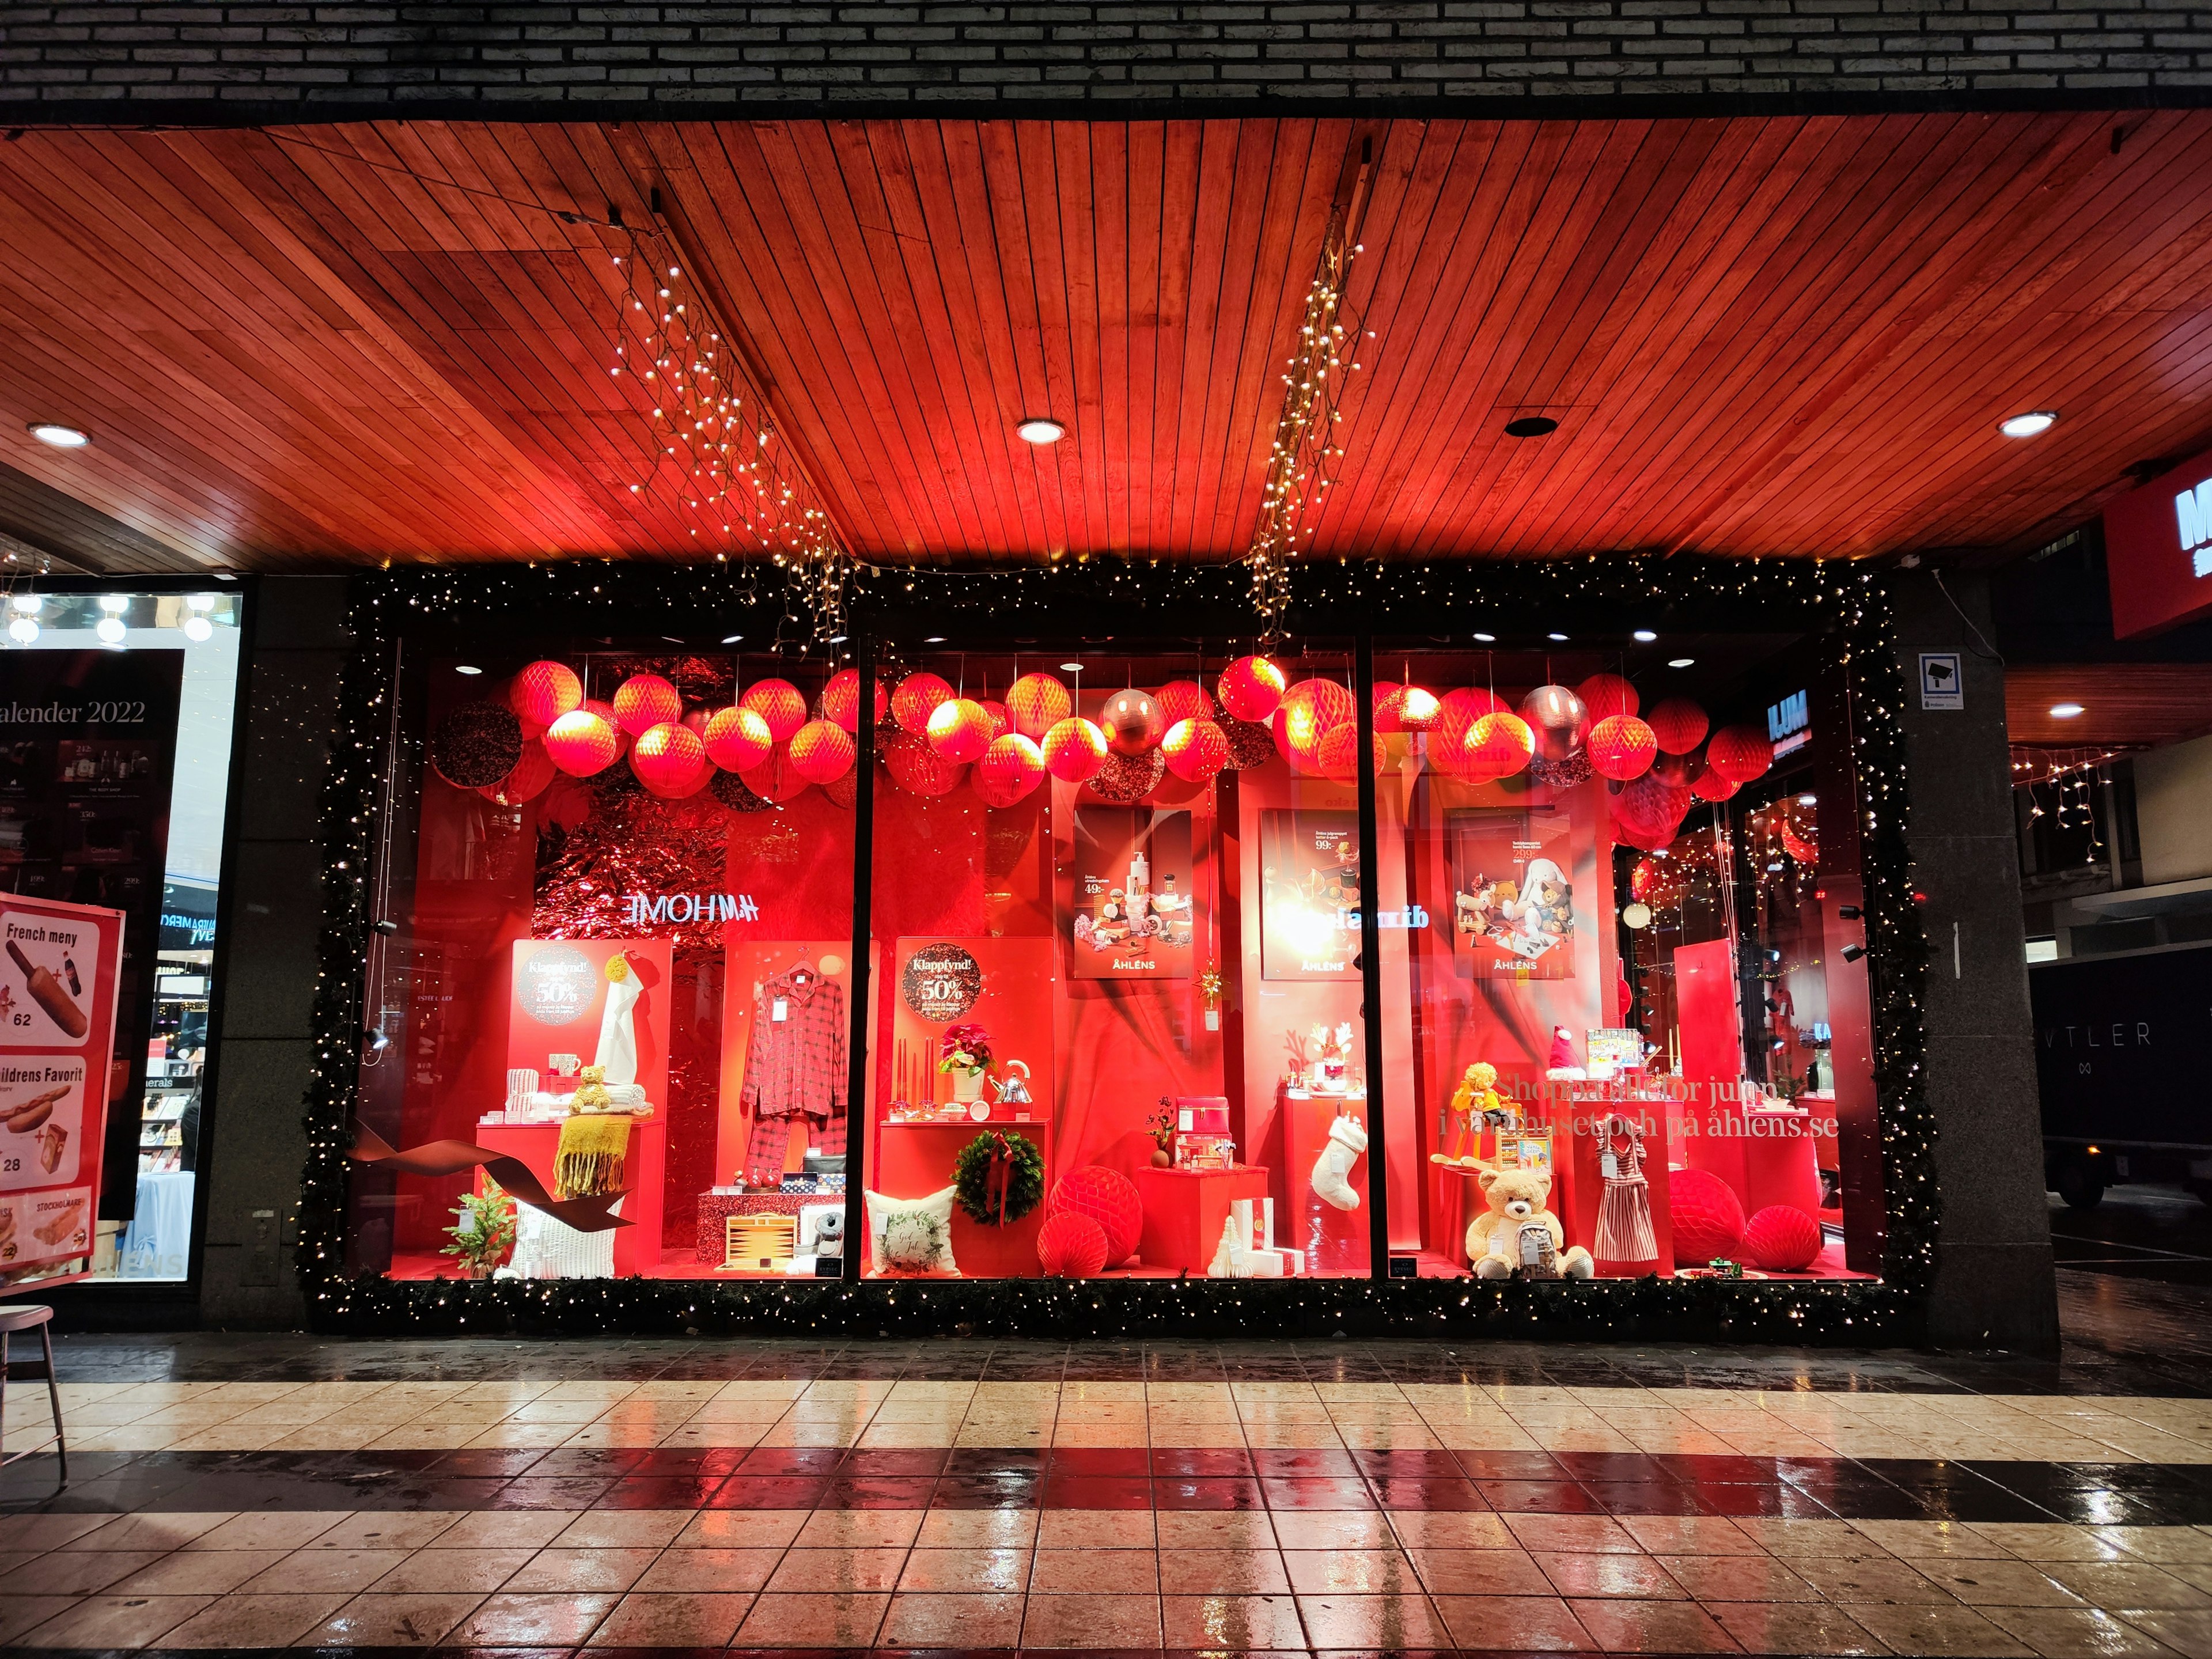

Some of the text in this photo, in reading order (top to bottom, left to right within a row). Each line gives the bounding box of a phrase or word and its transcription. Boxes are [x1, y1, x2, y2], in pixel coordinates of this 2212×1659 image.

[86, 701, 145, 724] 2022
[1315, 840, 1335, 850] 99:-
[1513, 849, 1539, 859] 299:-
[1084, 884, 1105, 894] 49:-
[6, 923, 77, 948] French meny
[912, 959, 972, 972] Klappfynd!
[1112, 959, 1156, 969] ÅHLÉNS
[1301, 960, 1345, 972] ÅHLÉNS
[1494, 959, 1537, 970] ÅHLÉNS
[536, 982, 578, 1002] 50%
[921, 980, 963, 1000] 50%
[13, 1013, 31, 1026] 62
[44, 1067, 82, 1082] Favorit
[1496, 1073, 1603, 1109] Shoppa
[1615, 1073, 1655, 1101] allt
[1709, 1074, 1778, 1110] julen
[1438, 1108, 1840, 1146] i varuhuset och på åhlens.se
[3, 1158, 21, 1172] 28
[3, 1247, 13, 1257] 22
[905, 1241, 919, 1253] Jul
